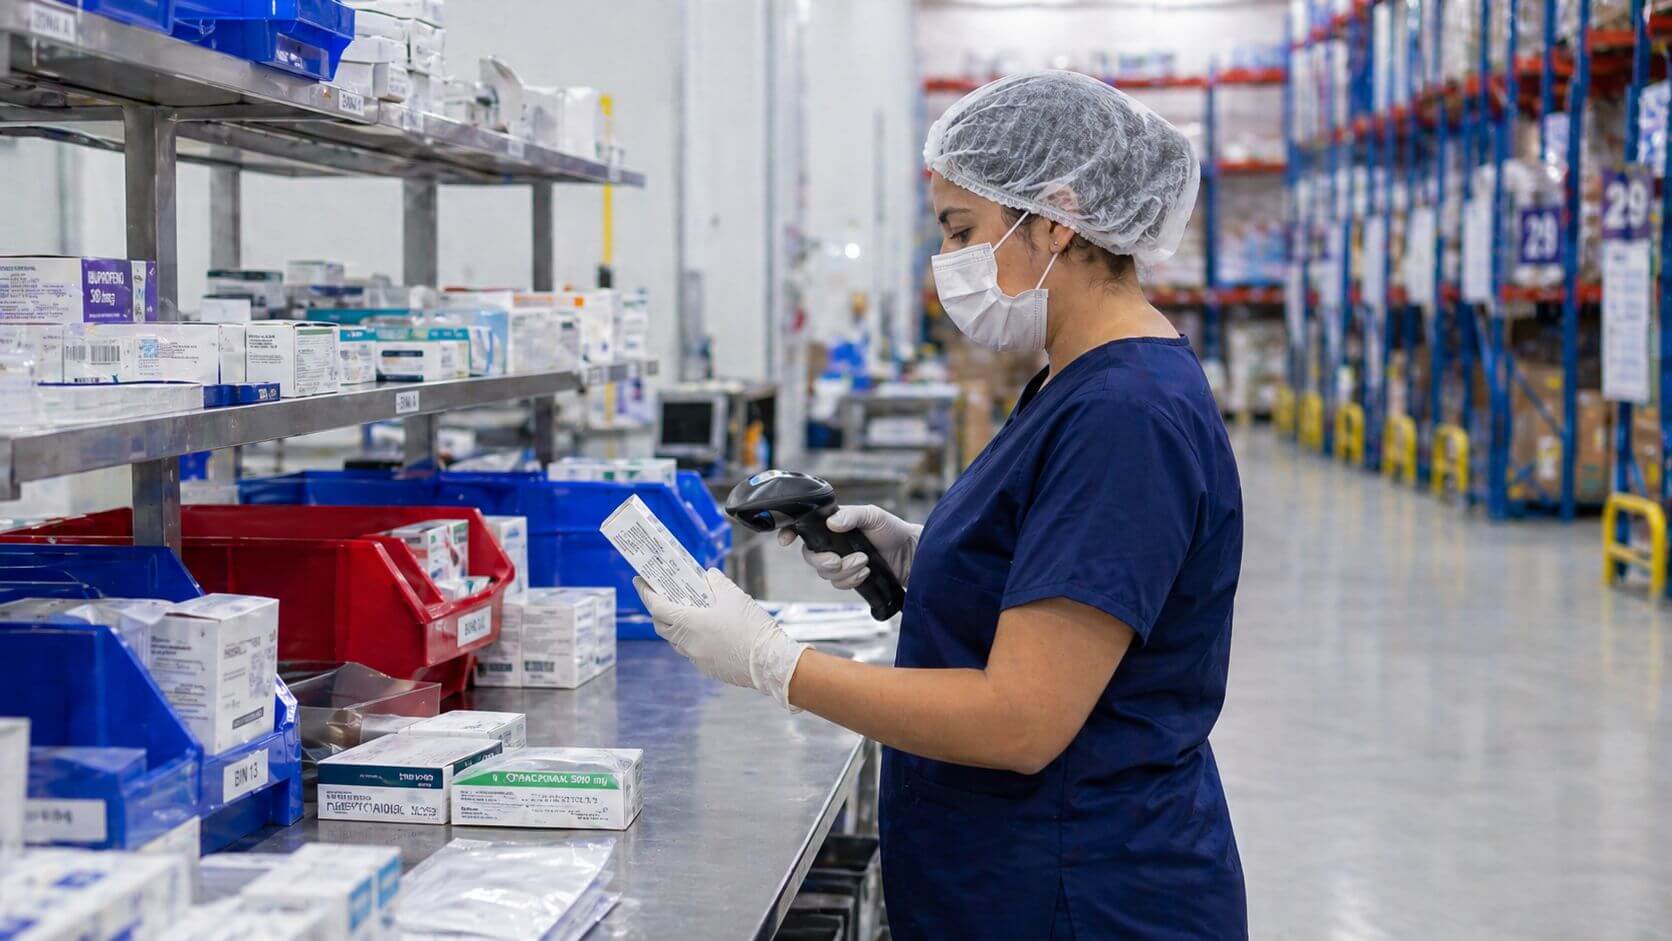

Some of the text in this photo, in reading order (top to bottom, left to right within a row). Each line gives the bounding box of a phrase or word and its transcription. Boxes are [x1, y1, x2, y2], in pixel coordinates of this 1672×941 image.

[1605, 181, 1648, 231] 29
[1524, 214, 1558, 260] 29
[234, 761, 258, 788] BIN 13
